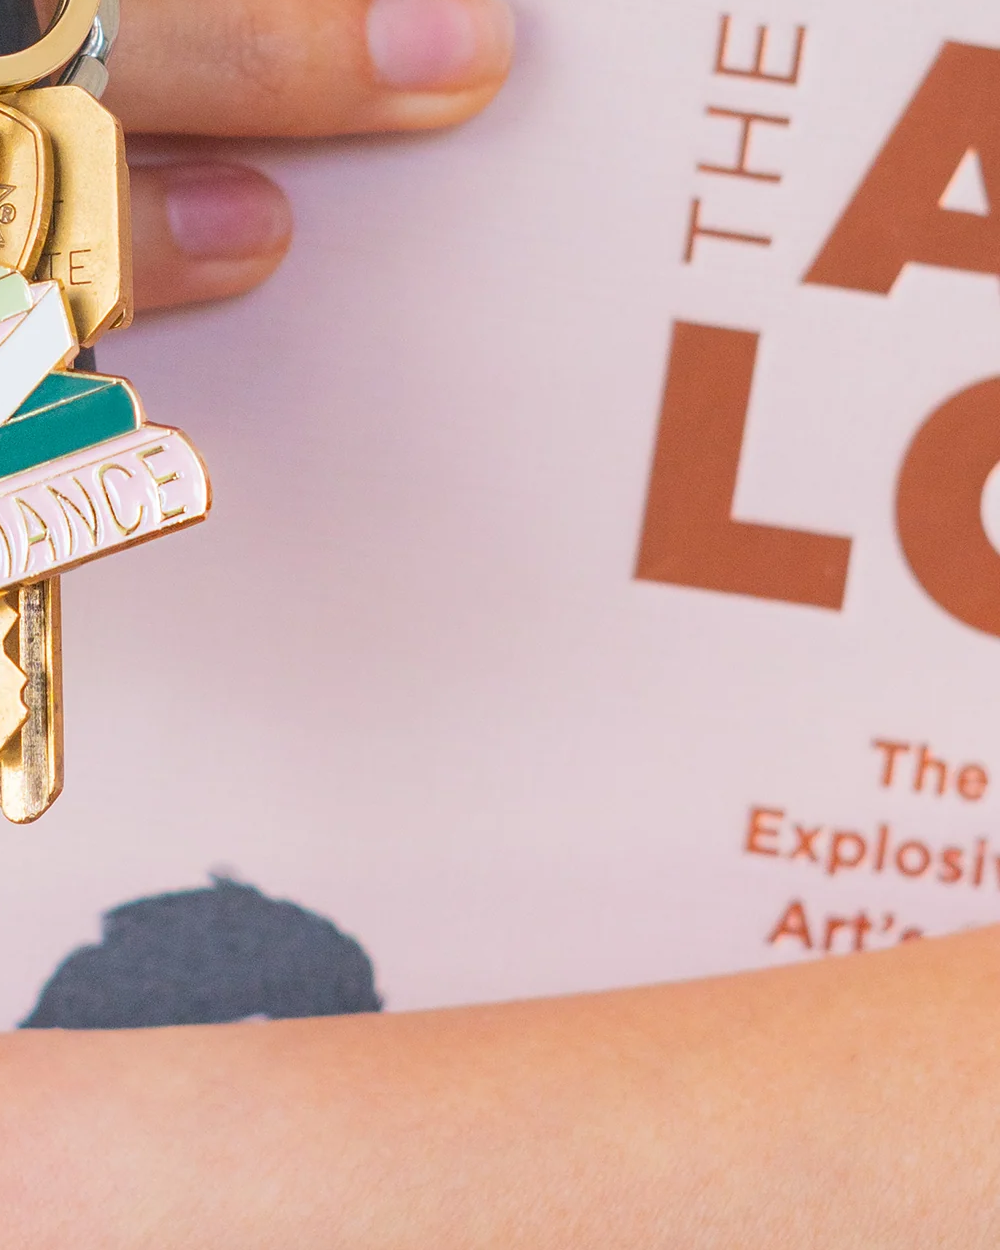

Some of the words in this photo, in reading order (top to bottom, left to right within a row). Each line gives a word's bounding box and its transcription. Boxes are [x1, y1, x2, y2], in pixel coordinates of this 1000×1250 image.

[683, 12, 806, 265] THE
[872, 736, 989, 801] The
[744, 803, 1000, 891] Explosi
